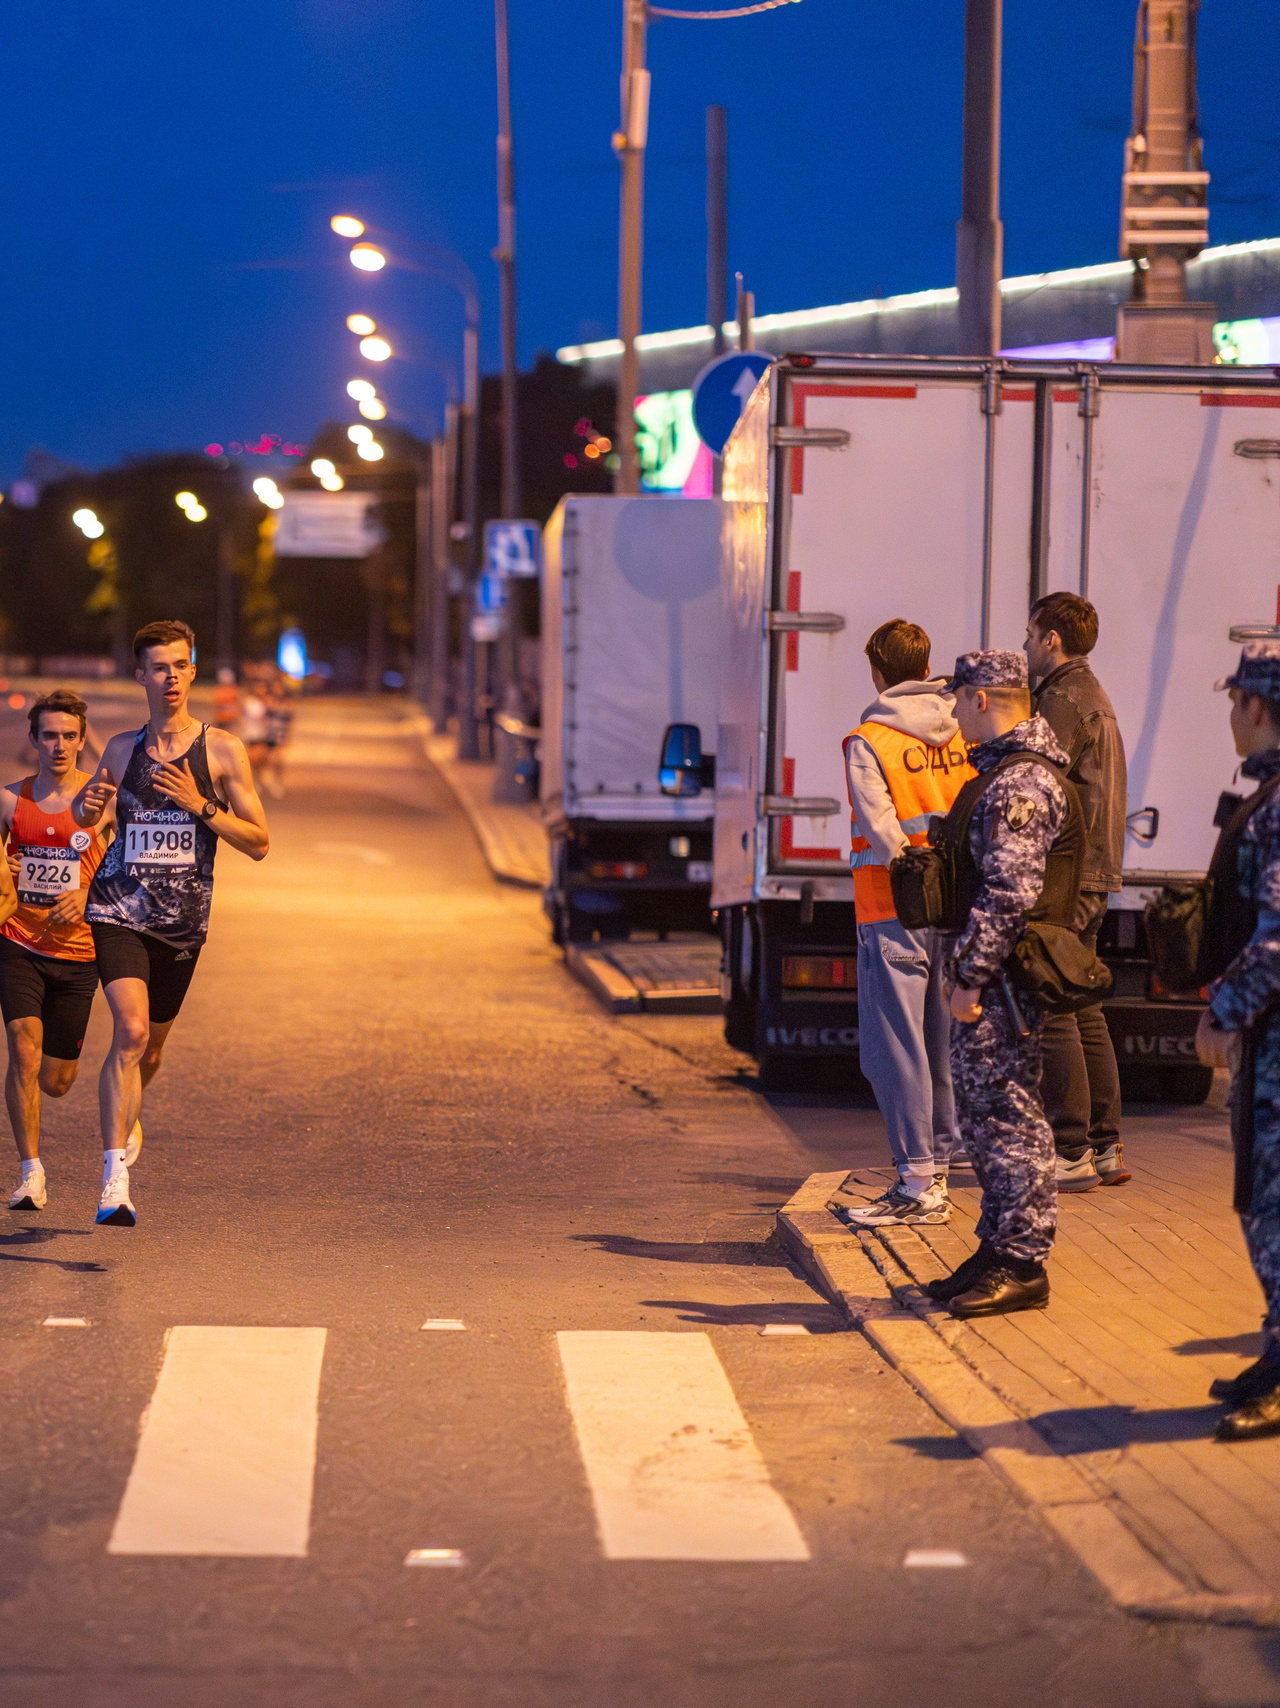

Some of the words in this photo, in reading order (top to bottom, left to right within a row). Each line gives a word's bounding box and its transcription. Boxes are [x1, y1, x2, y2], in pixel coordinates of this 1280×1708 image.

[134, 810, 191, 822] НОЧНОЙ
[129, 830, 193, 850] 11908
[24, 846, 76, 858] НОЧНОЙ
[26, 862, 71, 883] 9226
[33, 882, 62, 890] ВАСИЛИЙ
[766, 1026, 859, 1046] IVECO
[1124, 1035, 1196, 1056] IVEC
